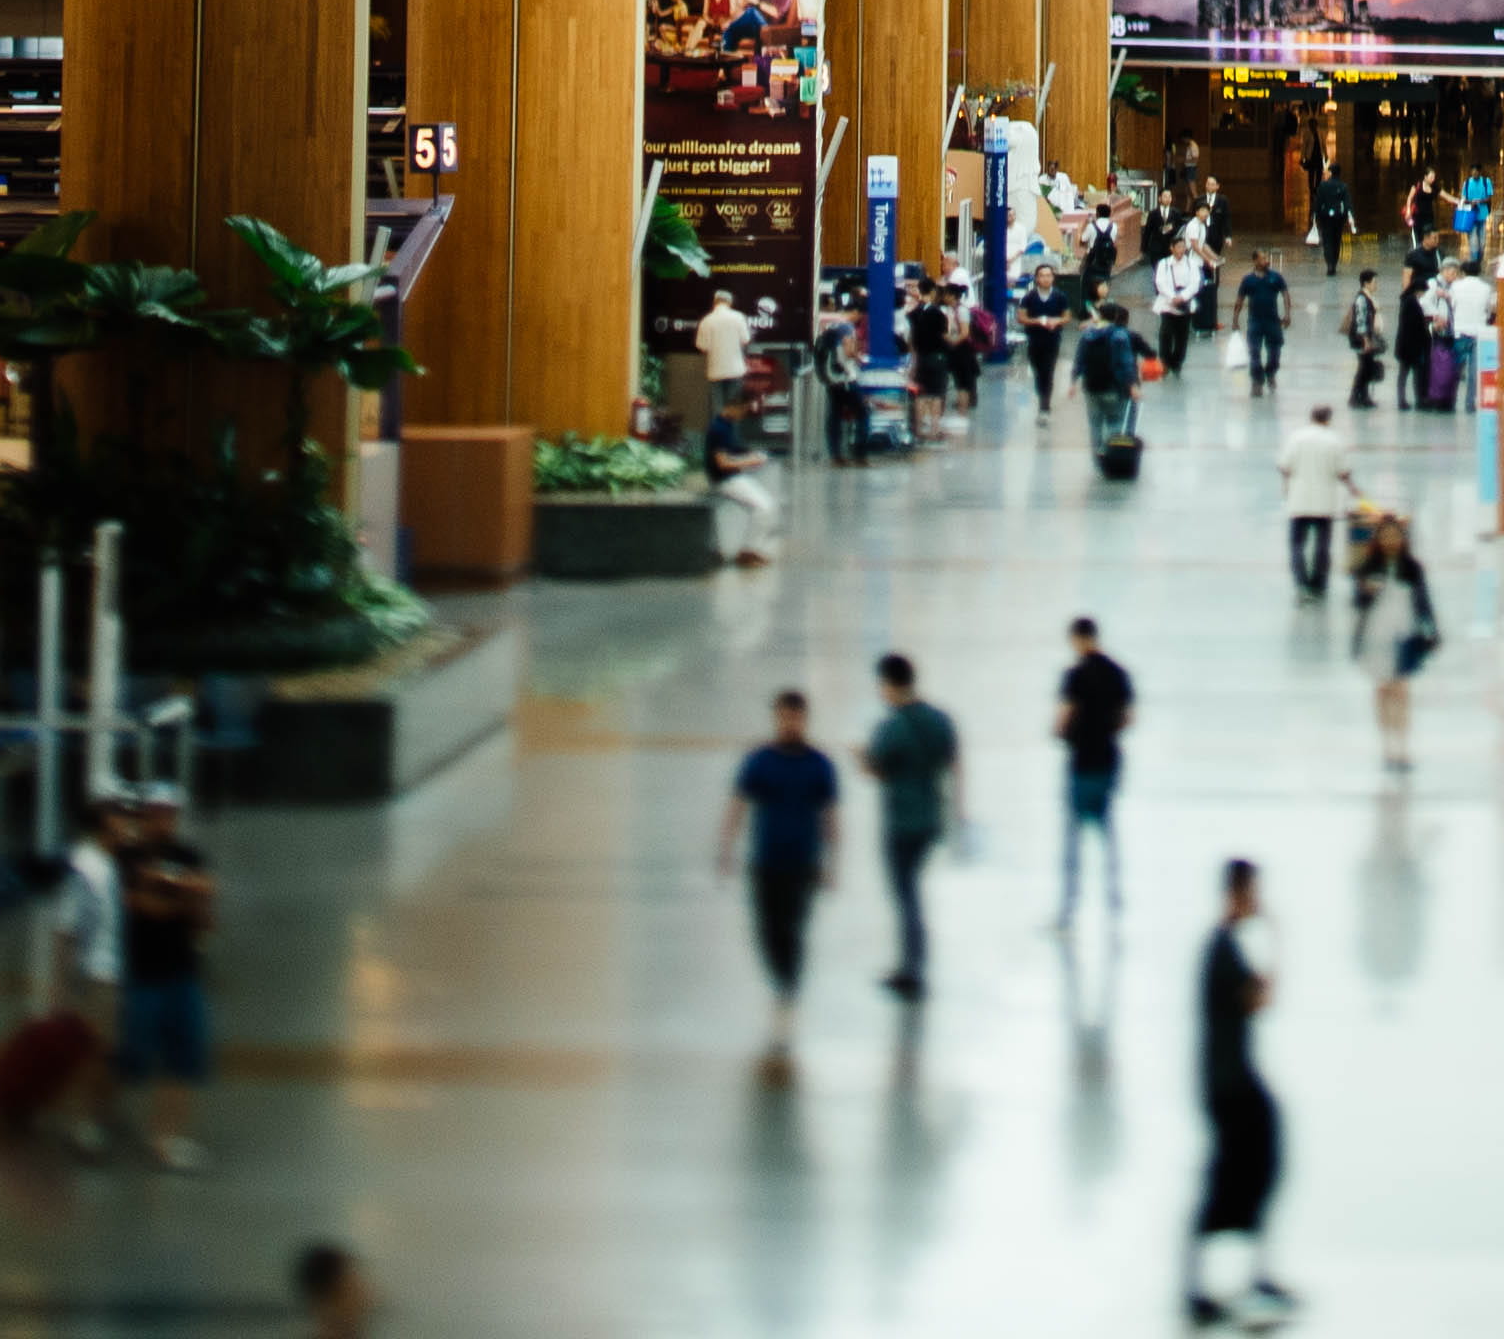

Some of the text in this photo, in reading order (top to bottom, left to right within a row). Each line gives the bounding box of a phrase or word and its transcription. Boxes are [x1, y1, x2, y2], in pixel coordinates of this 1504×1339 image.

[415, 127, 436, 169] 5
[442, 126, 457, 168] 5
[669, 139, 746, 155] millionaire
[748, 140, 801, 155] dreams
[663, 157, 770, 175] just got bigger!
[716, 203, 758, 216] VOLVO
[773, 202, 792, 217] 2X
[872, 202, 890, 264] Trolleys
